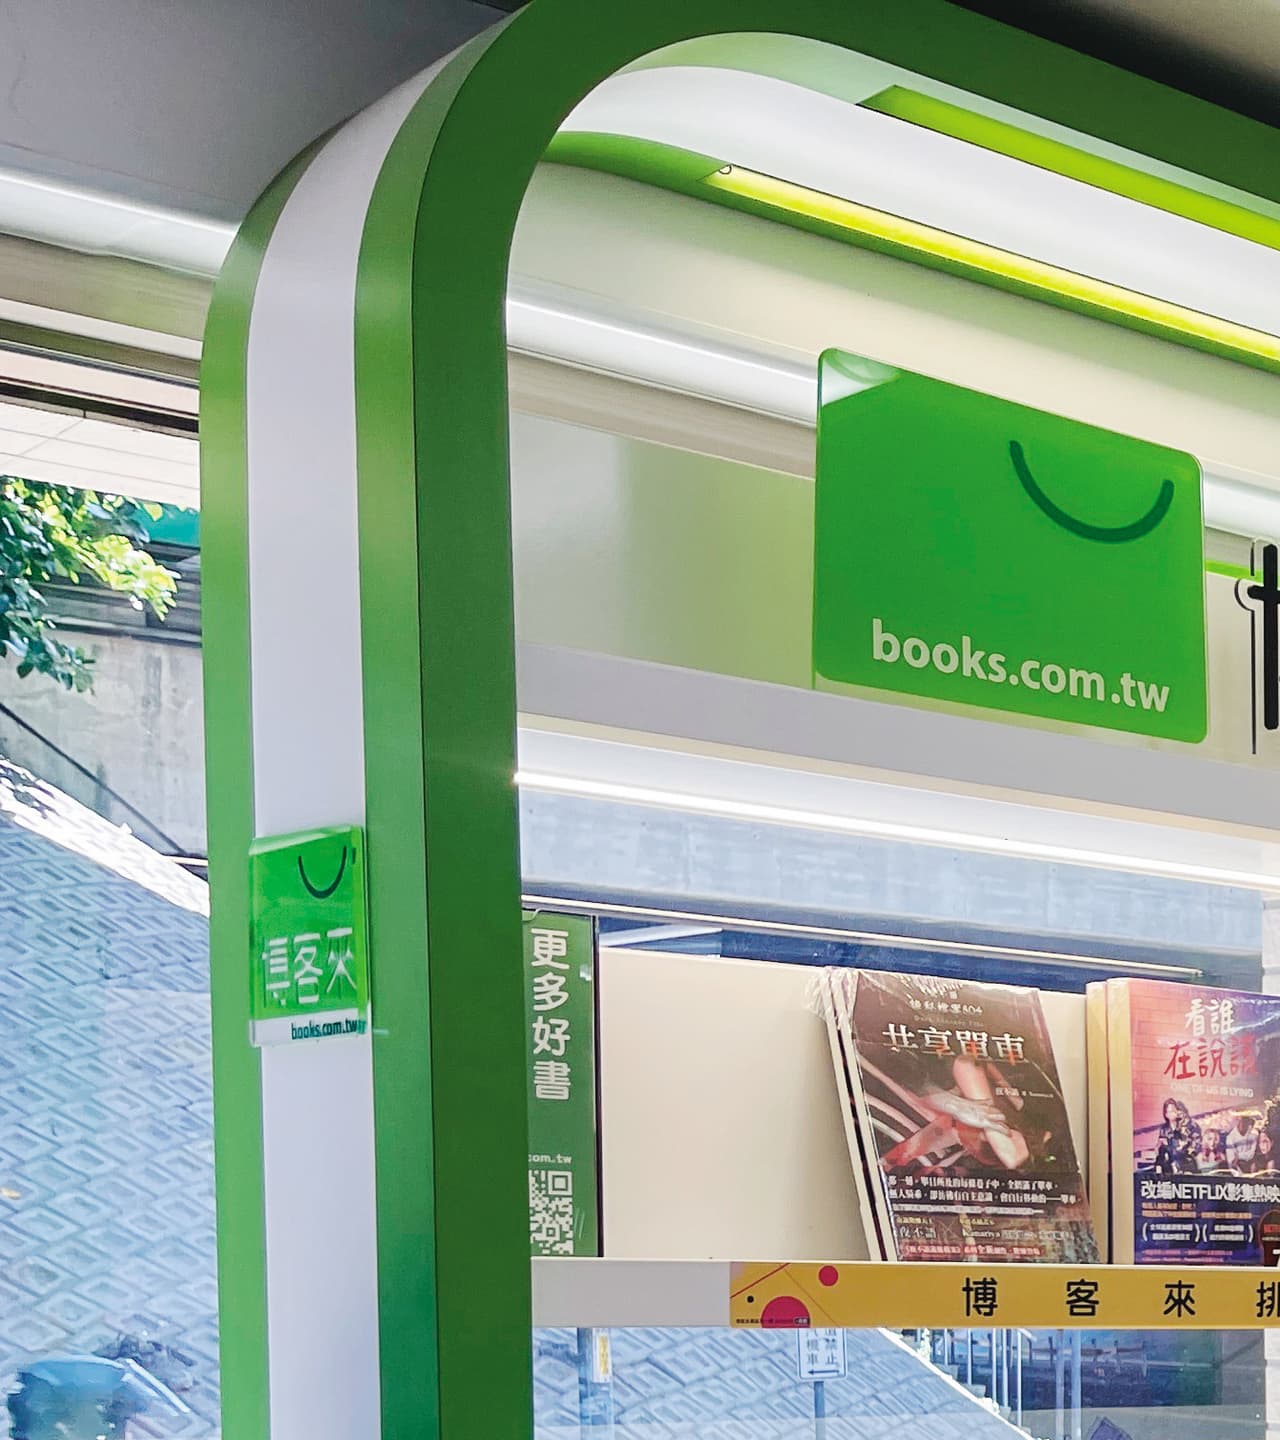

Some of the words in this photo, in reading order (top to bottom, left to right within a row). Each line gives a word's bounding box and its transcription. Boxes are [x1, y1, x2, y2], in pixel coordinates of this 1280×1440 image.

[872, 617, 1170, 714] books.com.tw
[531, 928, 571, 1101] 更多好書
[1185, 999, 1234, 1036] 看誰
[1230, 1087, 1254, 1098] LYING
